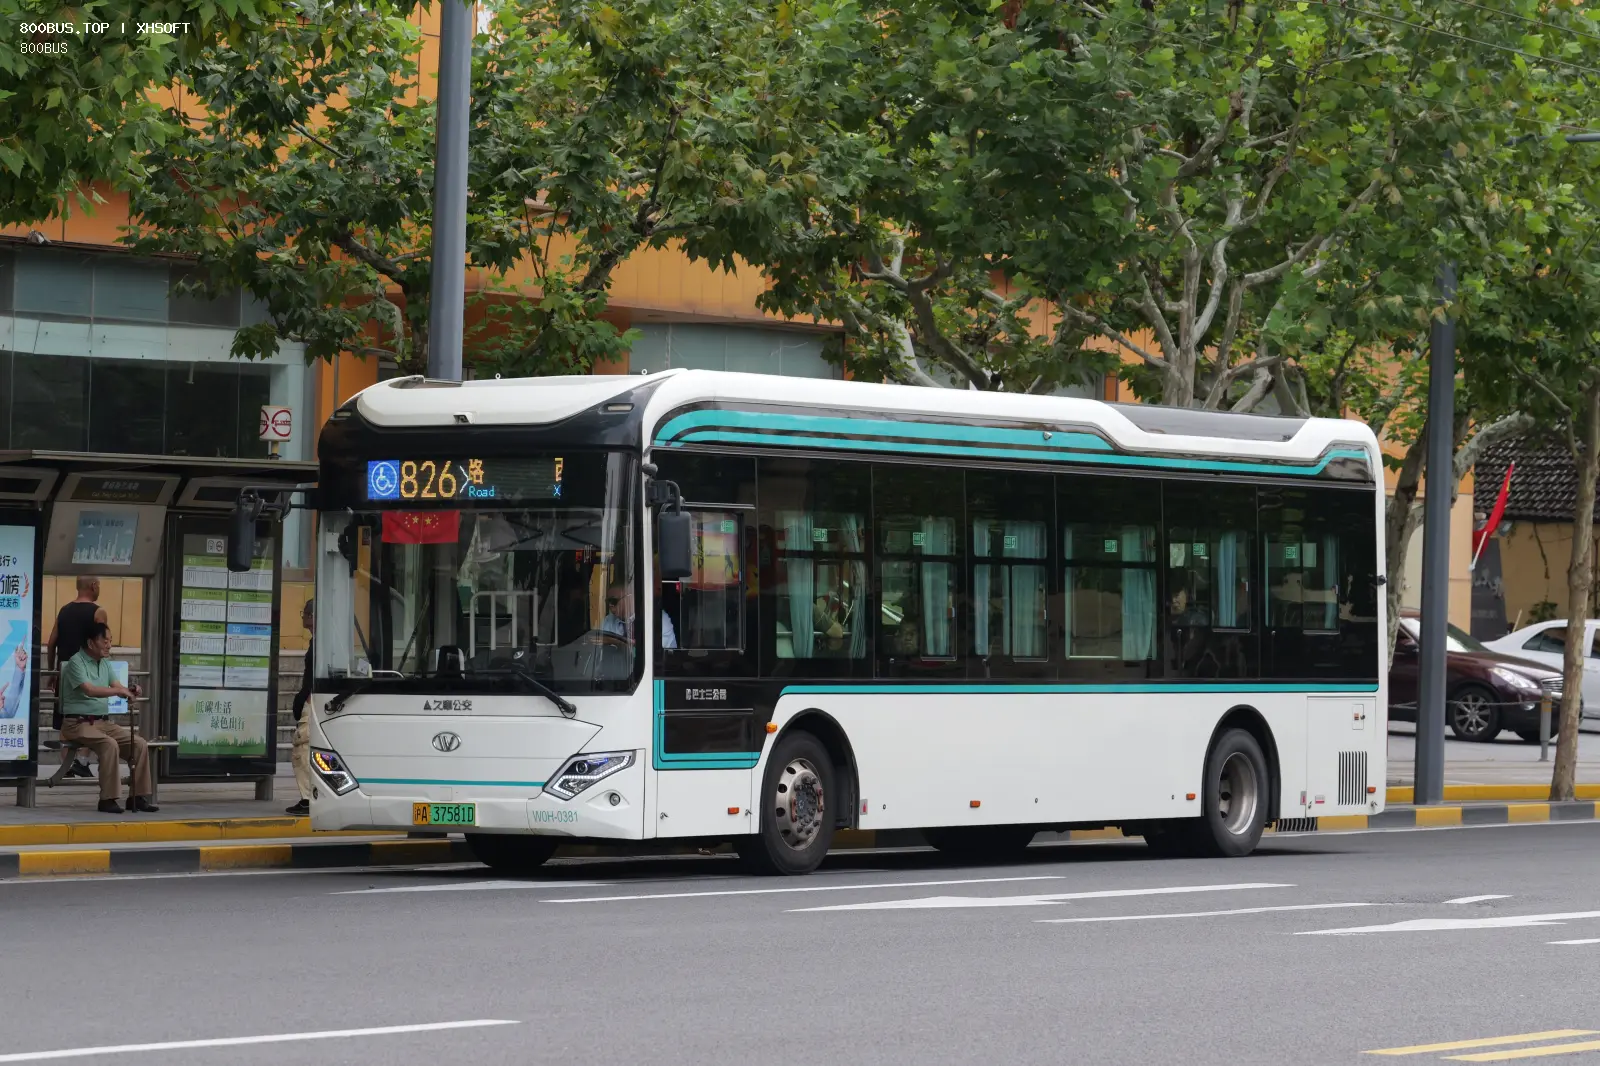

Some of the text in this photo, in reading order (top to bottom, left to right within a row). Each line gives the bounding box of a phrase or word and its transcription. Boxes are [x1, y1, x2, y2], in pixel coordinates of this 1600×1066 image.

[400, 460, 457, 498] 826
[468, 485, 495, 498] Road
[0, 555, 11, 567] 行
[195, 700, 232, 714] 低碳生活
[433, 806, 474, 822] 37581D
